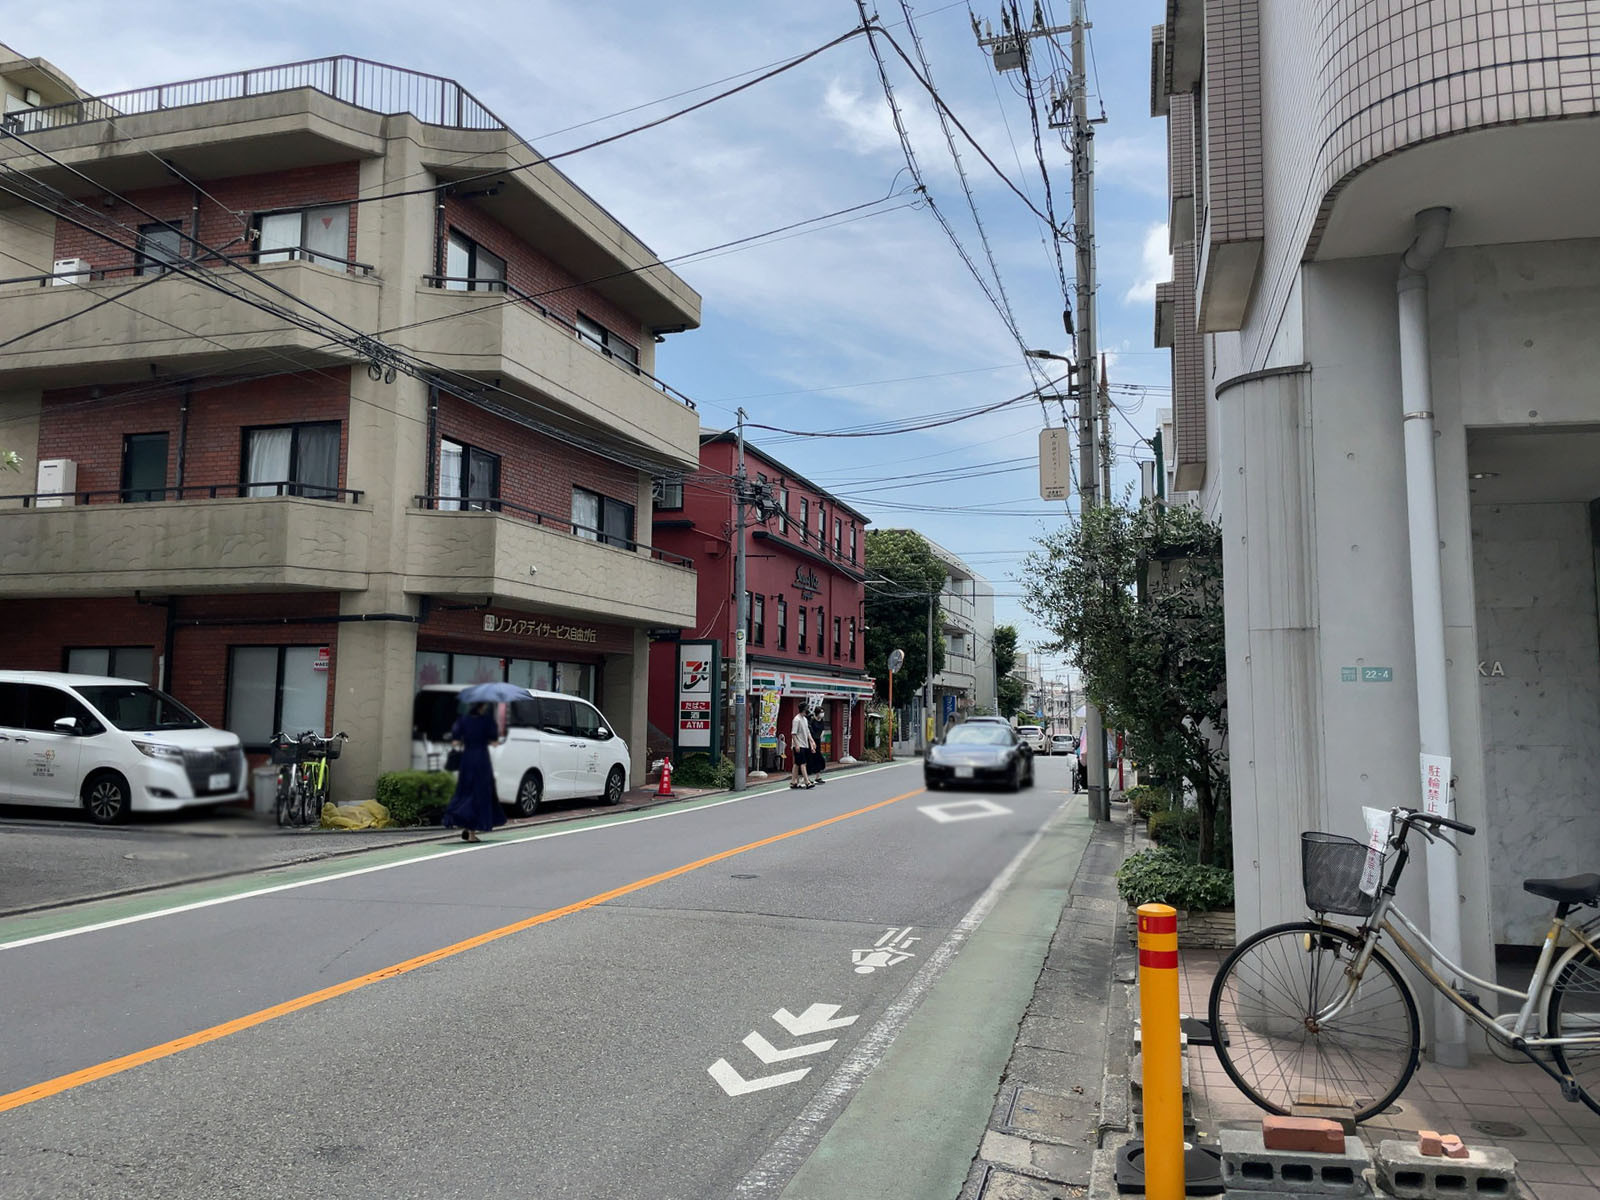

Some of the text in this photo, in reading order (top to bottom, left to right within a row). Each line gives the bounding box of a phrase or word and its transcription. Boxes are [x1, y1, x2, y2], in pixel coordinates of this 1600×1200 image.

[685, 702, 706, 710] たばこ
[686, 721, 704, 729] ATM
[1427, 764, 1441, 813] 駐輪禁止
